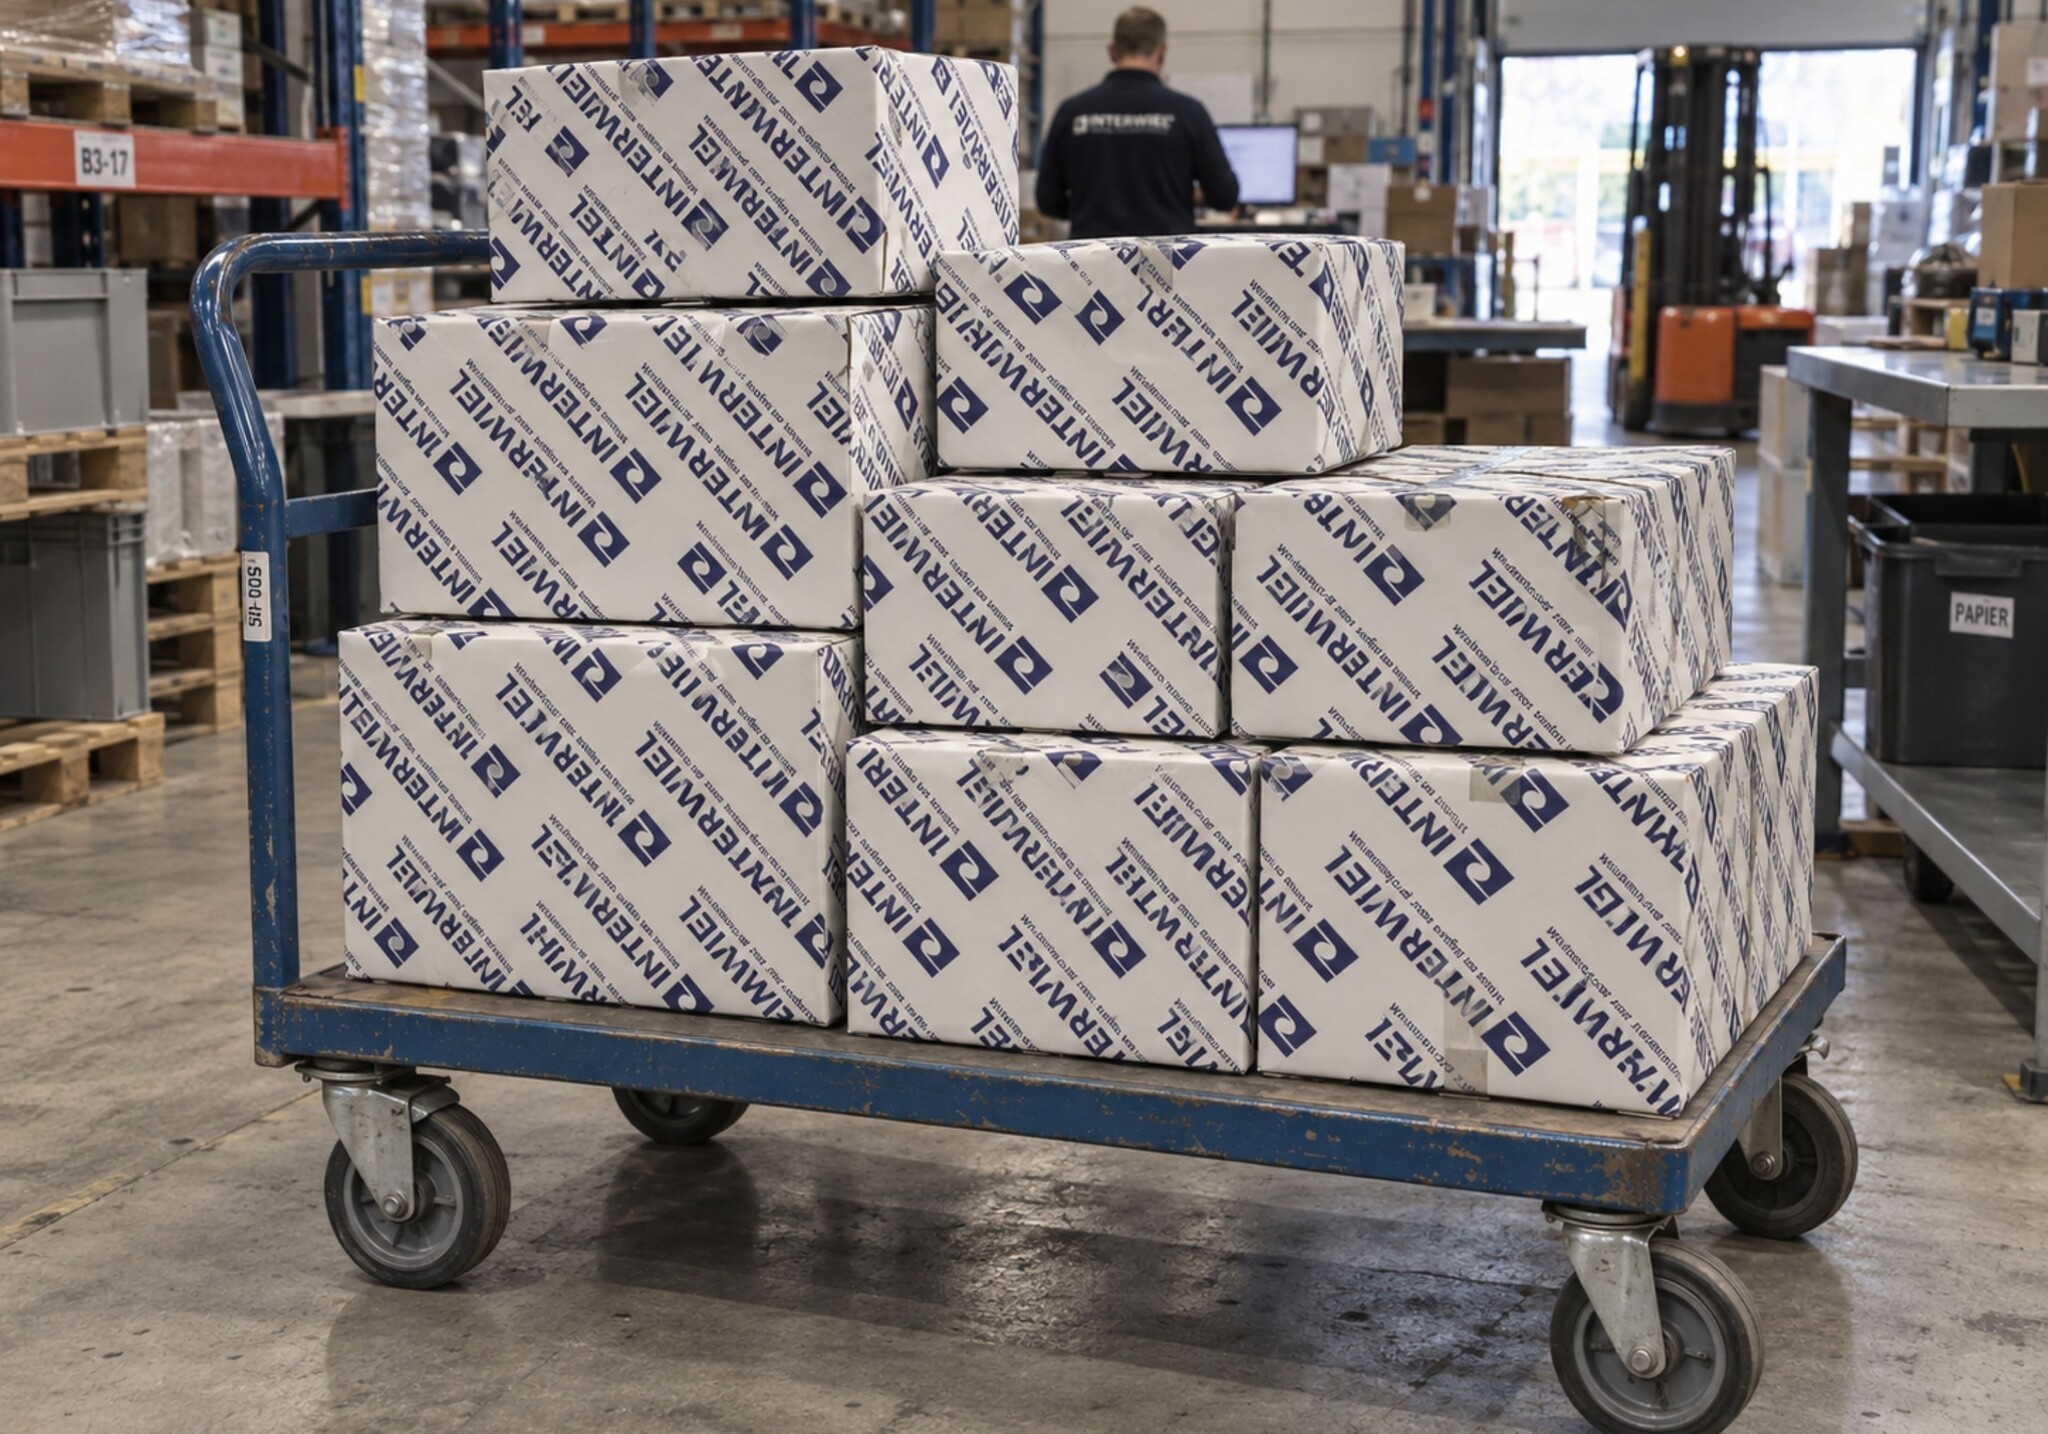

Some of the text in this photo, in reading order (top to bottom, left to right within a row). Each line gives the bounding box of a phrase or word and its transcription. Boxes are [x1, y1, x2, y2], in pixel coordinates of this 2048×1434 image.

[81, 147, 128, 176] B3-17
[570, 194, 640, 279] INTEL
[450, 369, 586, 527] INTERWIEL
[625, 372, 770, 540] INTERWIEL
[1955, 602, 2009, 628] PAPIER
[1325, 845, 1494, 1027] INTERWIEL
